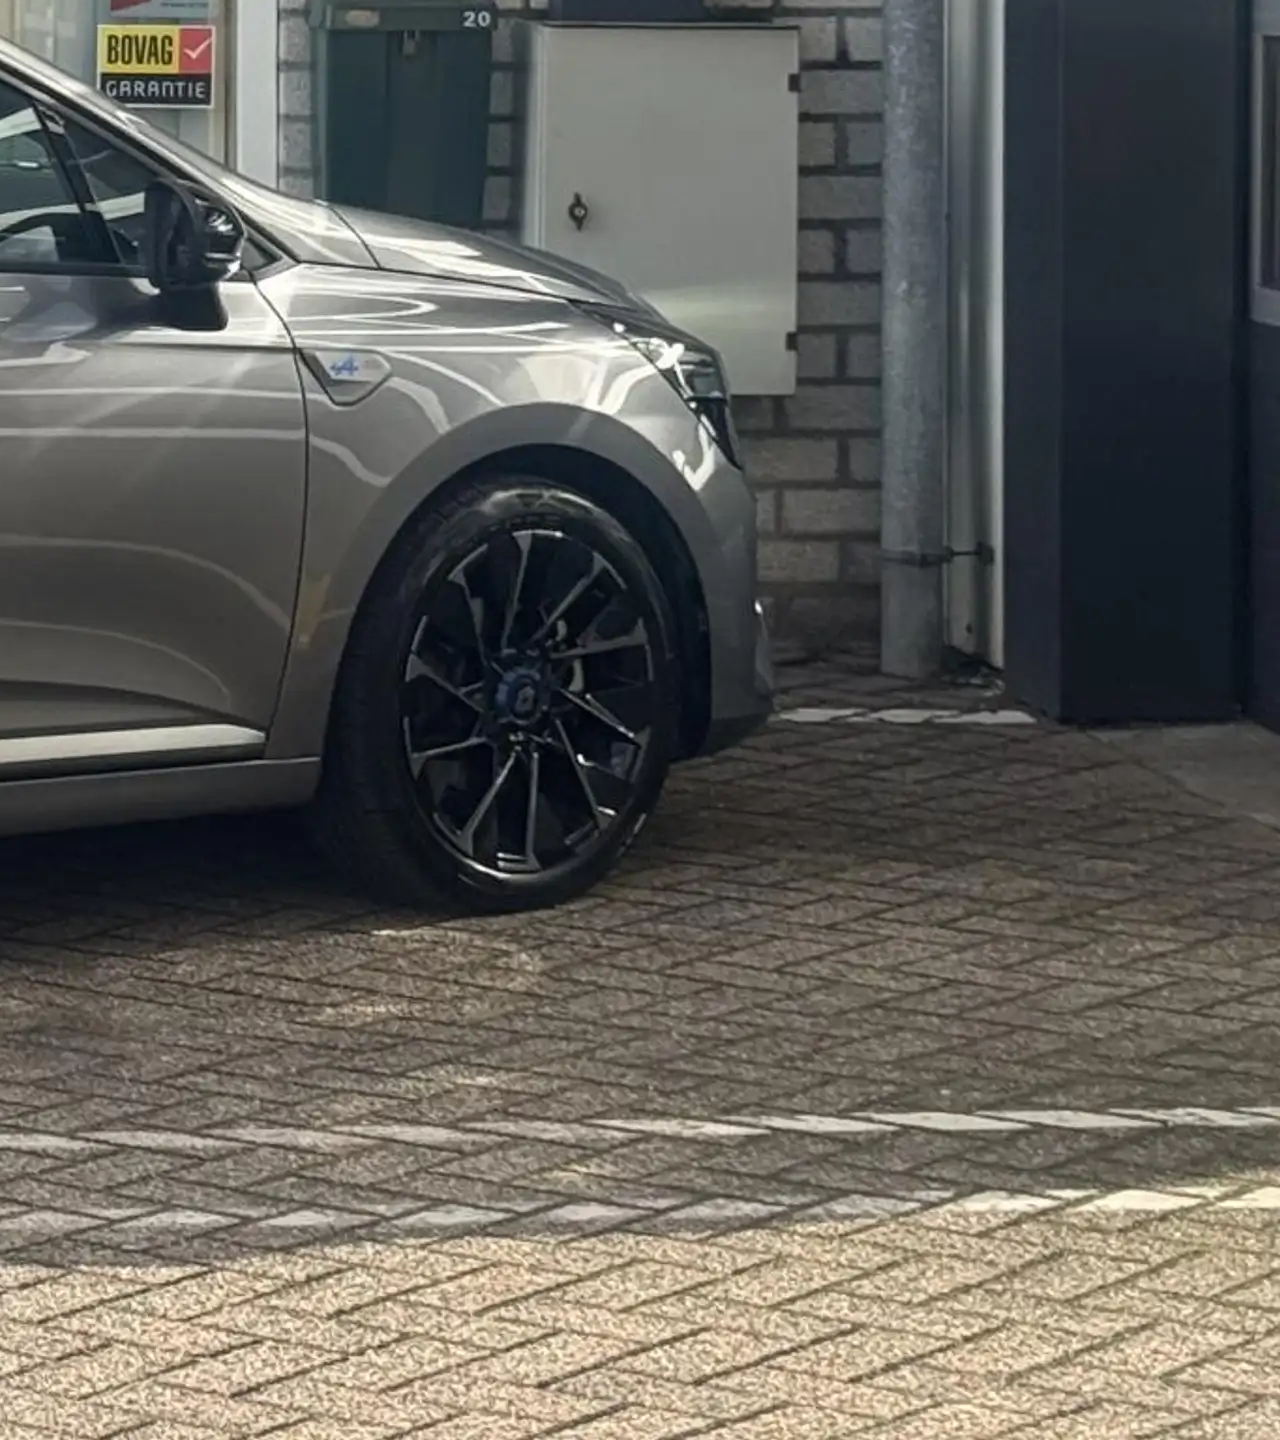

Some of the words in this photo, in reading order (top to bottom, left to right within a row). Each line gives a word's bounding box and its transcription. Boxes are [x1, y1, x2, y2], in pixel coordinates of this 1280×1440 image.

[463, 11, 491, 27] 20
[107, 34, 174, 65] BOVAG
[106, 80, 206, 98] GARANTIE
